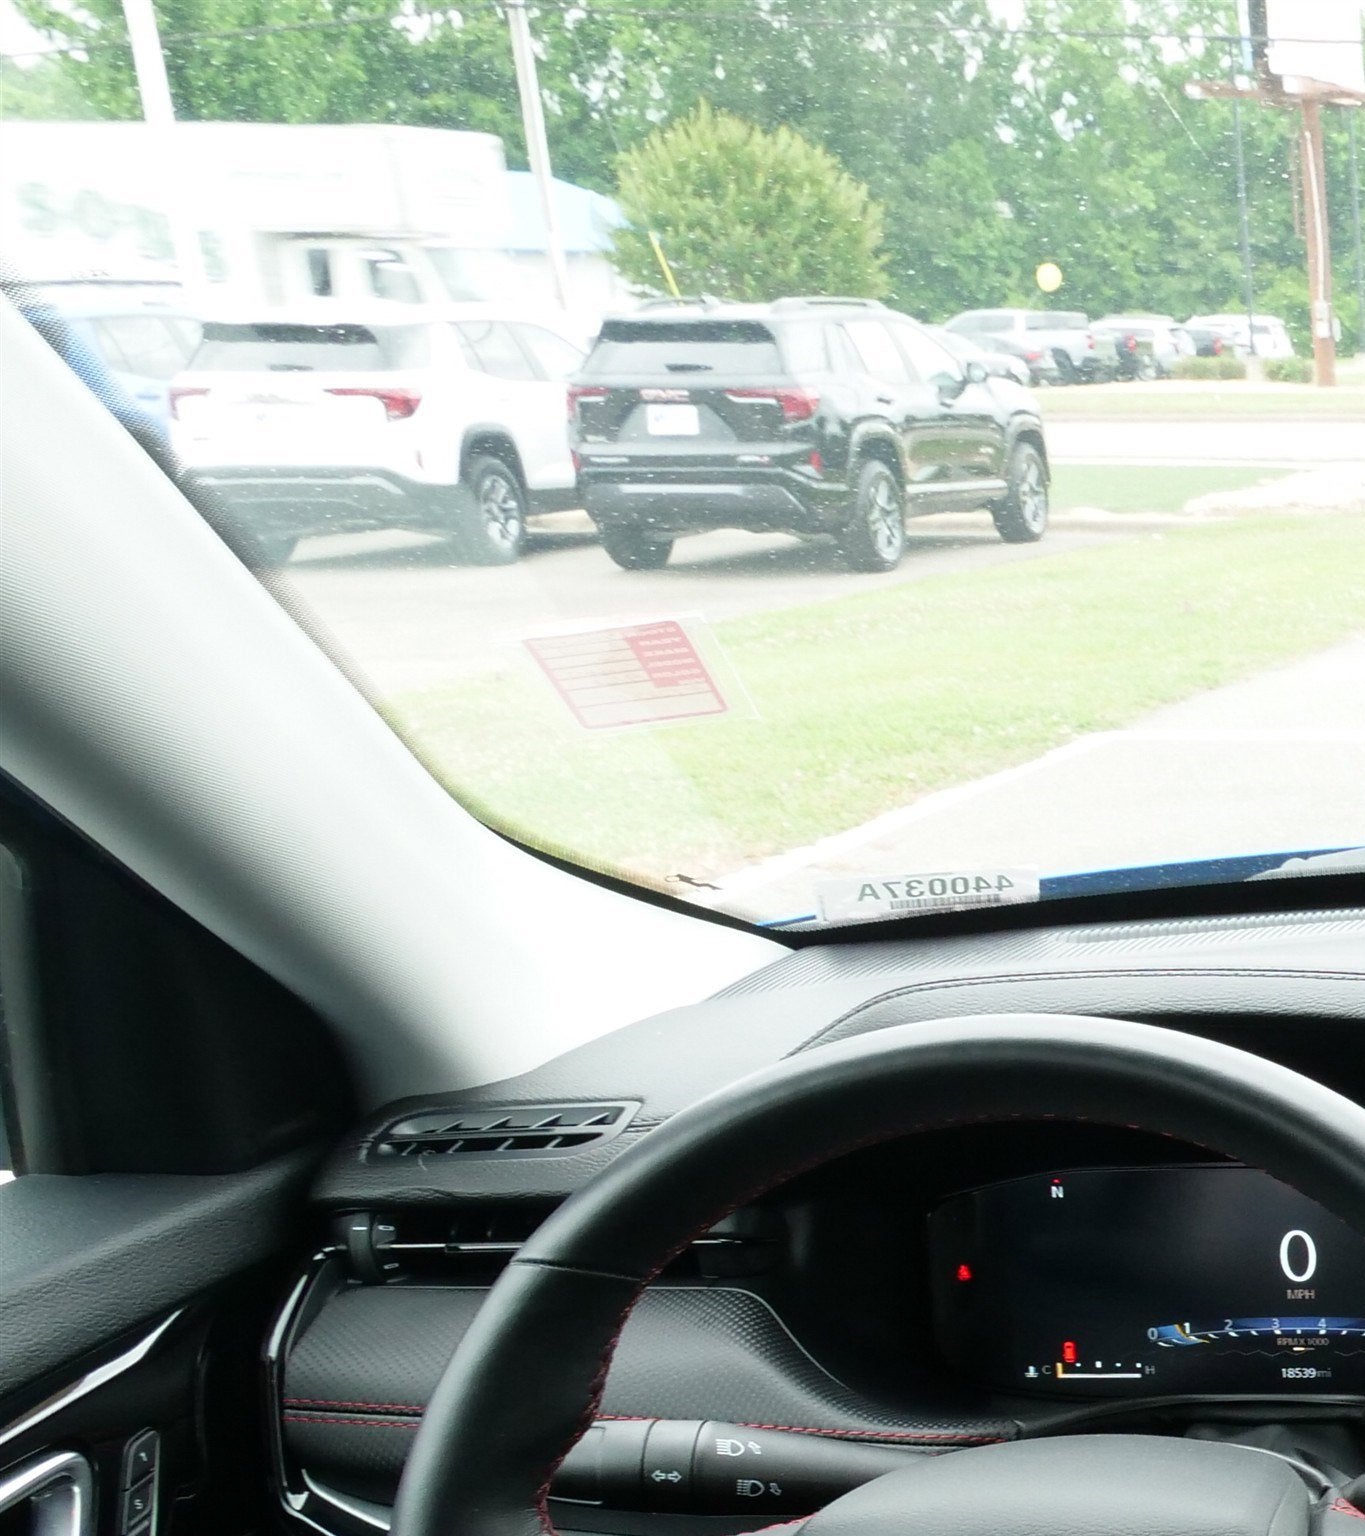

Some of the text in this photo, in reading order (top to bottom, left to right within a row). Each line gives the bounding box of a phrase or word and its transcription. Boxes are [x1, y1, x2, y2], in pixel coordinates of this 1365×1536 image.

[1051, 1185, 1065, 1198] N
[1279, 1229, 1318, 1283] 0
[1286, 1289, 1316, 1300] MPH
[1147, 1327, 1158, 1340] 0
[1184, 1322, 1191, 1334] 1
[1224, 1318, 1234, 1330] 2
[1271, 1317, 1281, 1330] 3
[1317, 1317, 1327, 1330] 4
[1277, 1337, 1299, 1346] RPM
[1041, 1364, 1052, 1375] C
[1144, 1364, 1156, 1375] H
